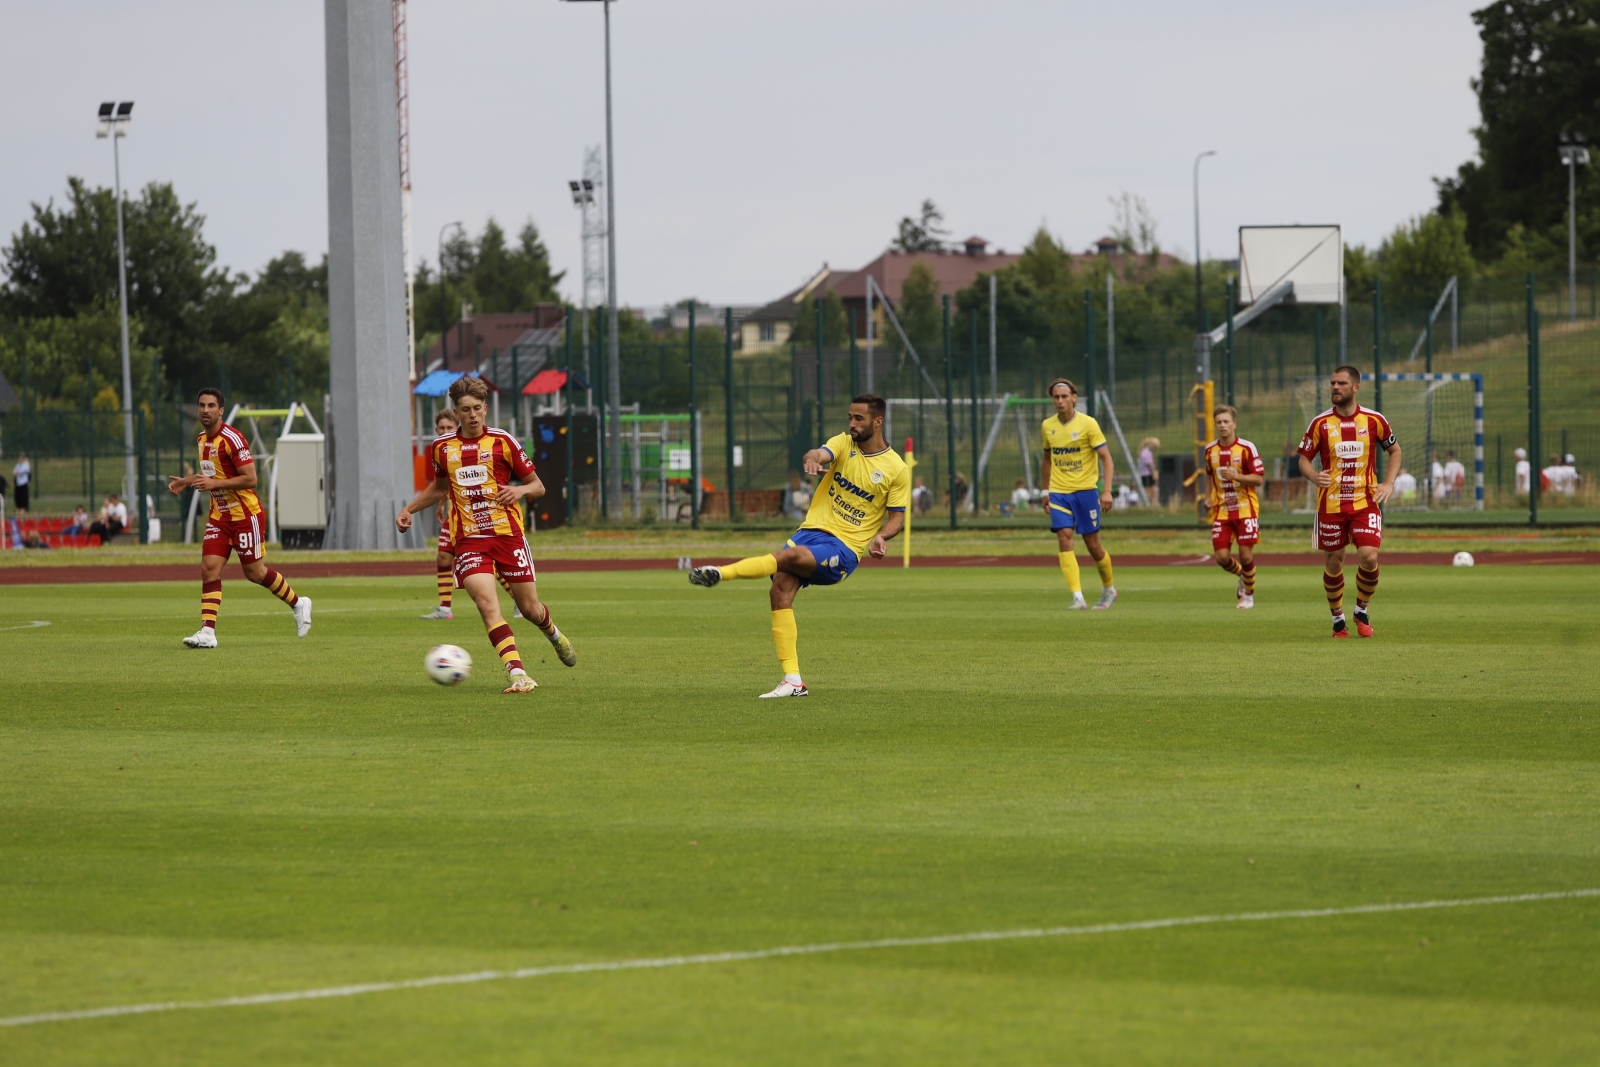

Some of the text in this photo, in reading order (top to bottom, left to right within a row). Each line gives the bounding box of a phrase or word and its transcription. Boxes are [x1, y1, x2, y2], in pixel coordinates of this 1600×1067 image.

[459, 470, 485, 479] Skiba
[461, 488, 493, 496] GINTER
[472, 501, 496, 510] EMKA
[833, 494, 866, 519] Energa
[1244, 518, 1258, 532] 34
[239, 532, 253, 549] 91
